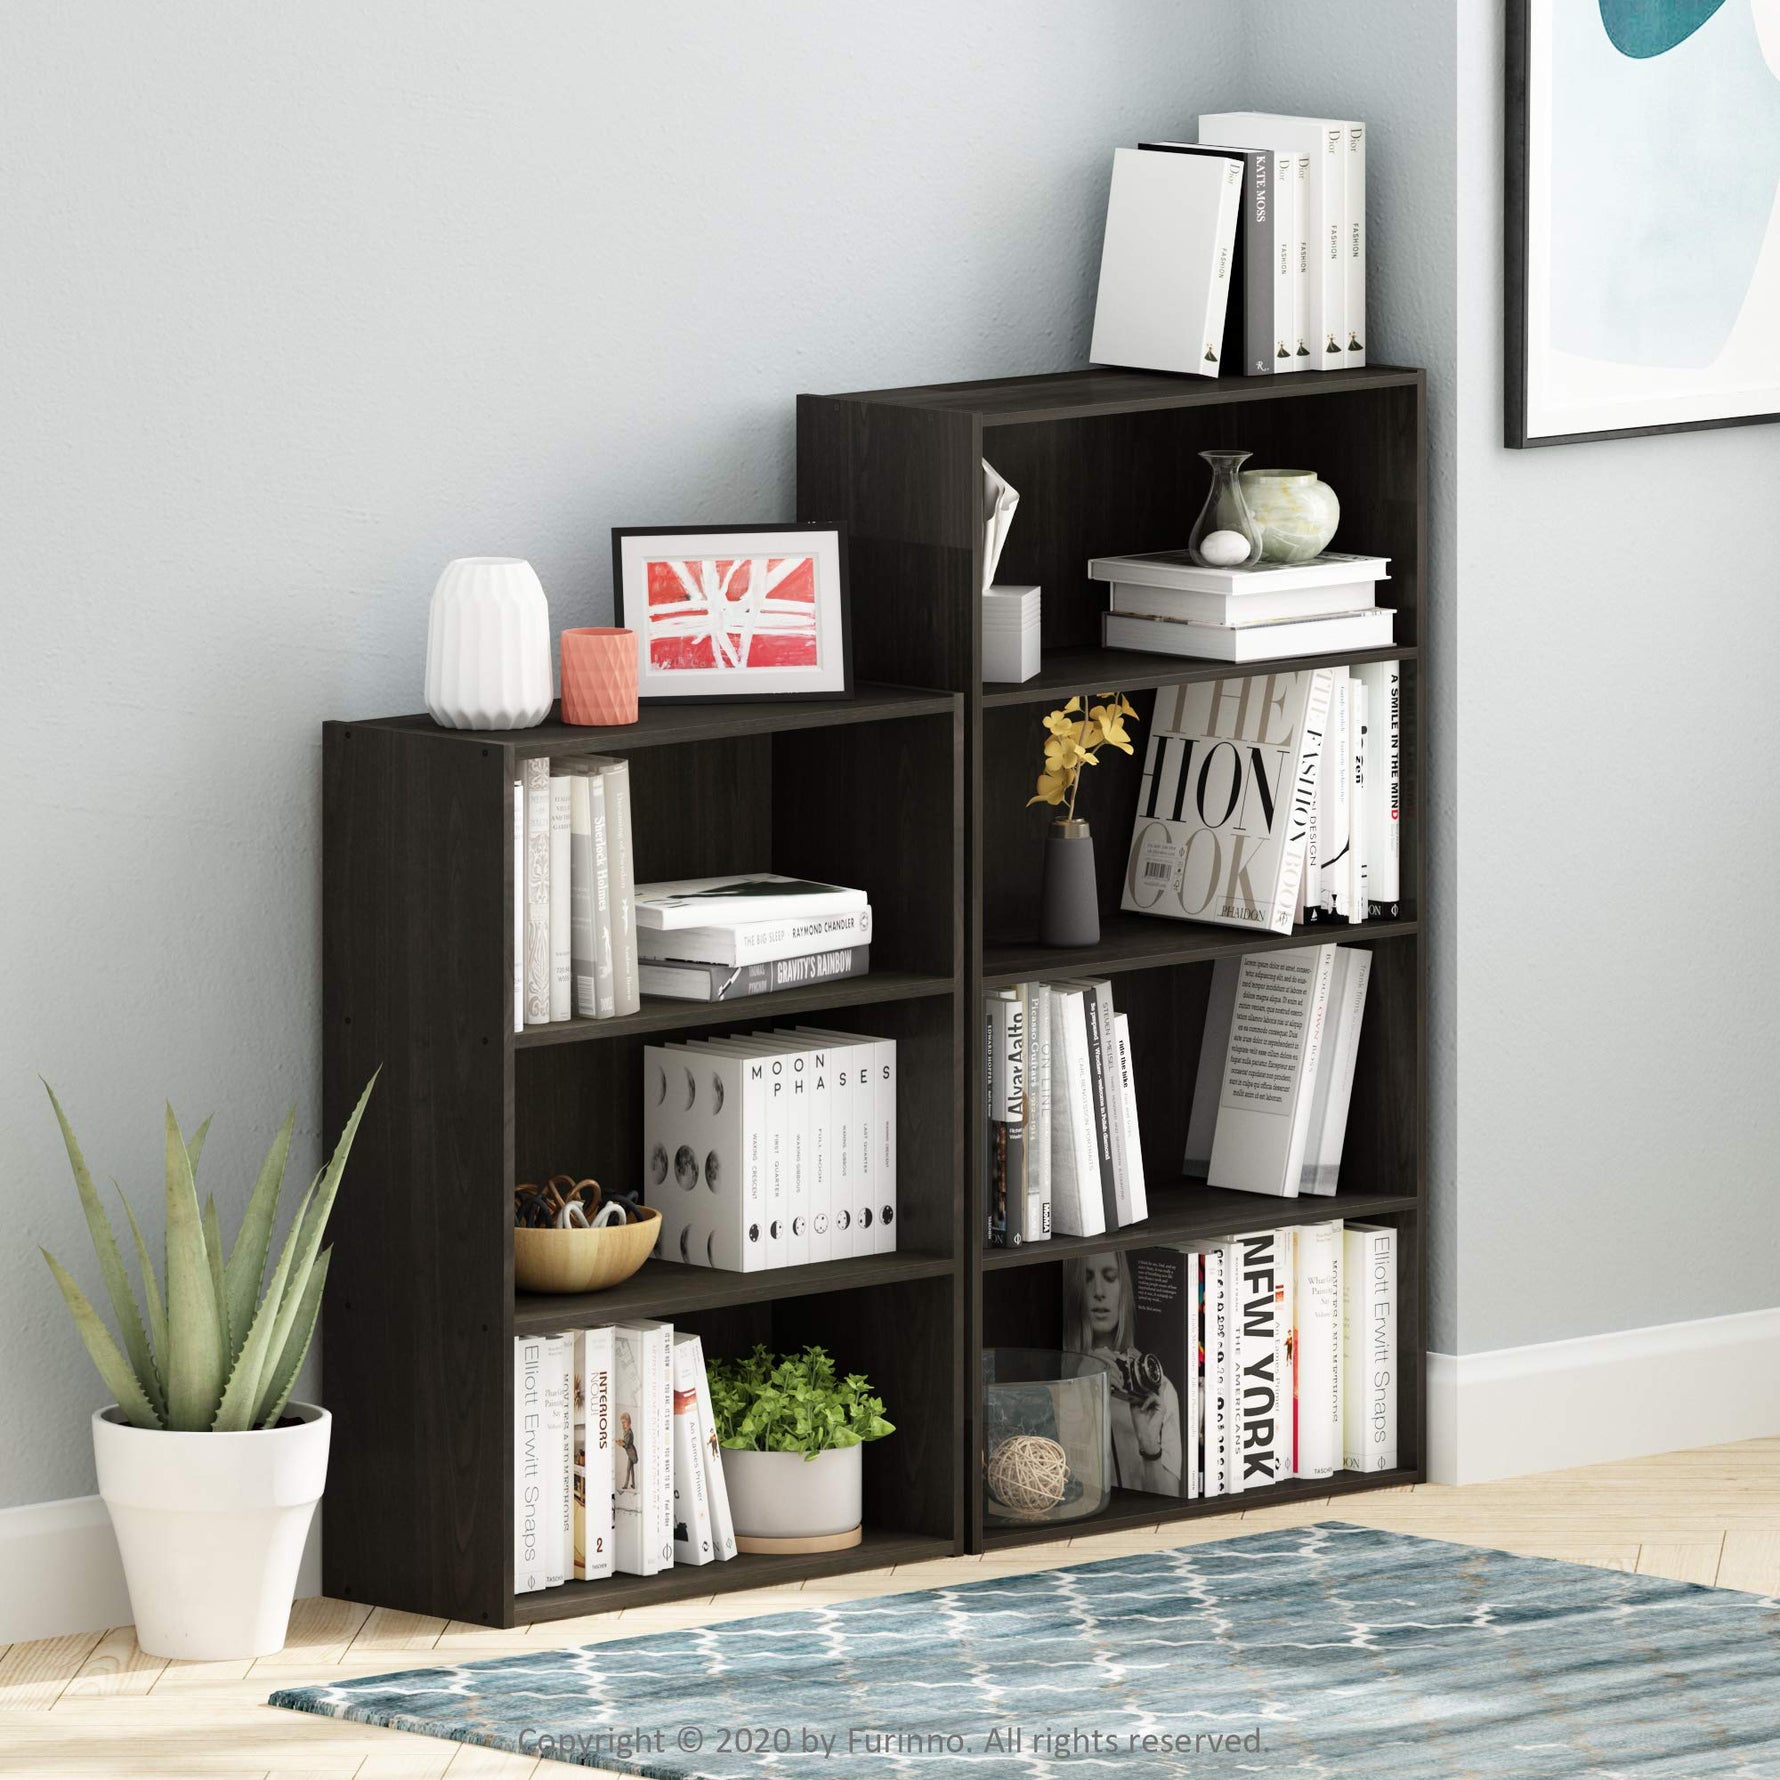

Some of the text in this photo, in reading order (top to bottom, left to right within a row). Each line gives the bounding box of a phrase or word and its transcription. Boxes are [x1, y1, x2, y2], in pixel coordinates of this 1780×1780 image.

[1328, 130, 1340, 154] Dior
[1350, 128, 1362, 152] Dior
[1229, 163, 1240, 185] Dior
[1278, 160, 1290, 182] Dior
[1298, 158, 1310, 180] Dior
[1256, 156, 1266, 222] KATE MOSS
[1218, 248, 1227, 279] FASHION
[1391, 674, 1398, 684] A
[1391, 734, 1399, 748] IN
[1289, 729, 1323, 842] FASHION
[1309, 816, 1318, 866] DESIGN
[594, 816, 608, 912] Sherlock Holmes
[1221, 905, 1266, 922] PHAIDON
[744, 918, 854, 947] THE BIG SLEEP RAYMOND CHANDLER
[777, 950, 852, 984] GRAVITY'S RAINBOW
[1358, 965, 1366, 988] frank
[1030, 998, 1040, 1040] Picasso
[1314, 1006, 1323, 1042] OWN
[1008, 1012, 1022, 1063] Aalto
[1102, 1002, 1114, 1072] STEVEN MEISEL
[752, 1054, 824, 1080] MOON
[1030, 1042, 1040, 1087] Guitars
[1042, 1044, 1050, 1068] ON
[774, 1066, 890, 1097] PHASES
[1008, 1066, 1022, 1116] Alvar
[1371, 1236, 1390, 1443] Elliott Erwitt Snaps
[590, 1372, 599, 1416] NOW!
[600, 1371, 608, 1449] INTERIORS
[1244, 1352, 1275, 1480] YORK
[522, 1345, 540, 1562] Elliott Erwitt Snaps
[690, 1422, 703, 1502] An Eames Primer
[596, 1538, 603, 1552] 2
